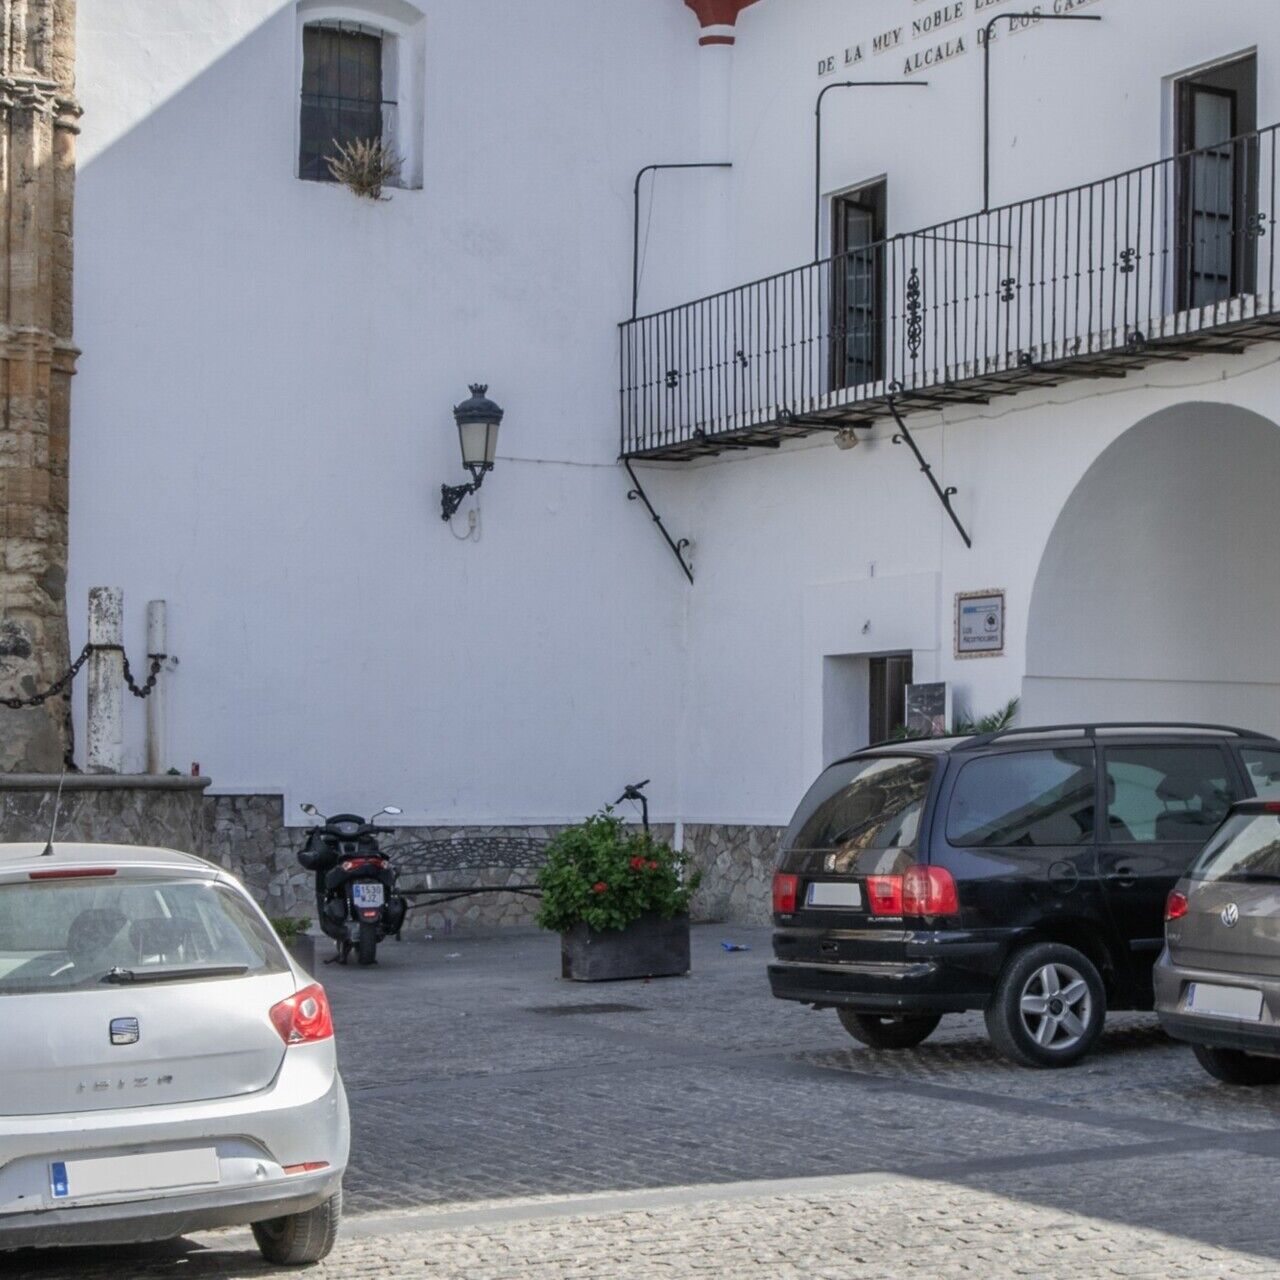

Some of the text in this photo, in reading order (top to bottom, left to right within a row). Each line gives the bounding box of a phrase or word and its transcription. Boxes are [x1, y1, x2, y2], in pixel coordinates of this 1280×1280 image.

[817, 56, 835, 75] DE
[844, 45, 863, 64] LA
[872, 27, 903, 52] MUY
[912, 2, 963, 36] NOBLE
[904, 37, 965, 73] ALCALA
[976, 22, 997, 45] DE
[1008, 5, 1042, 32] LOS
